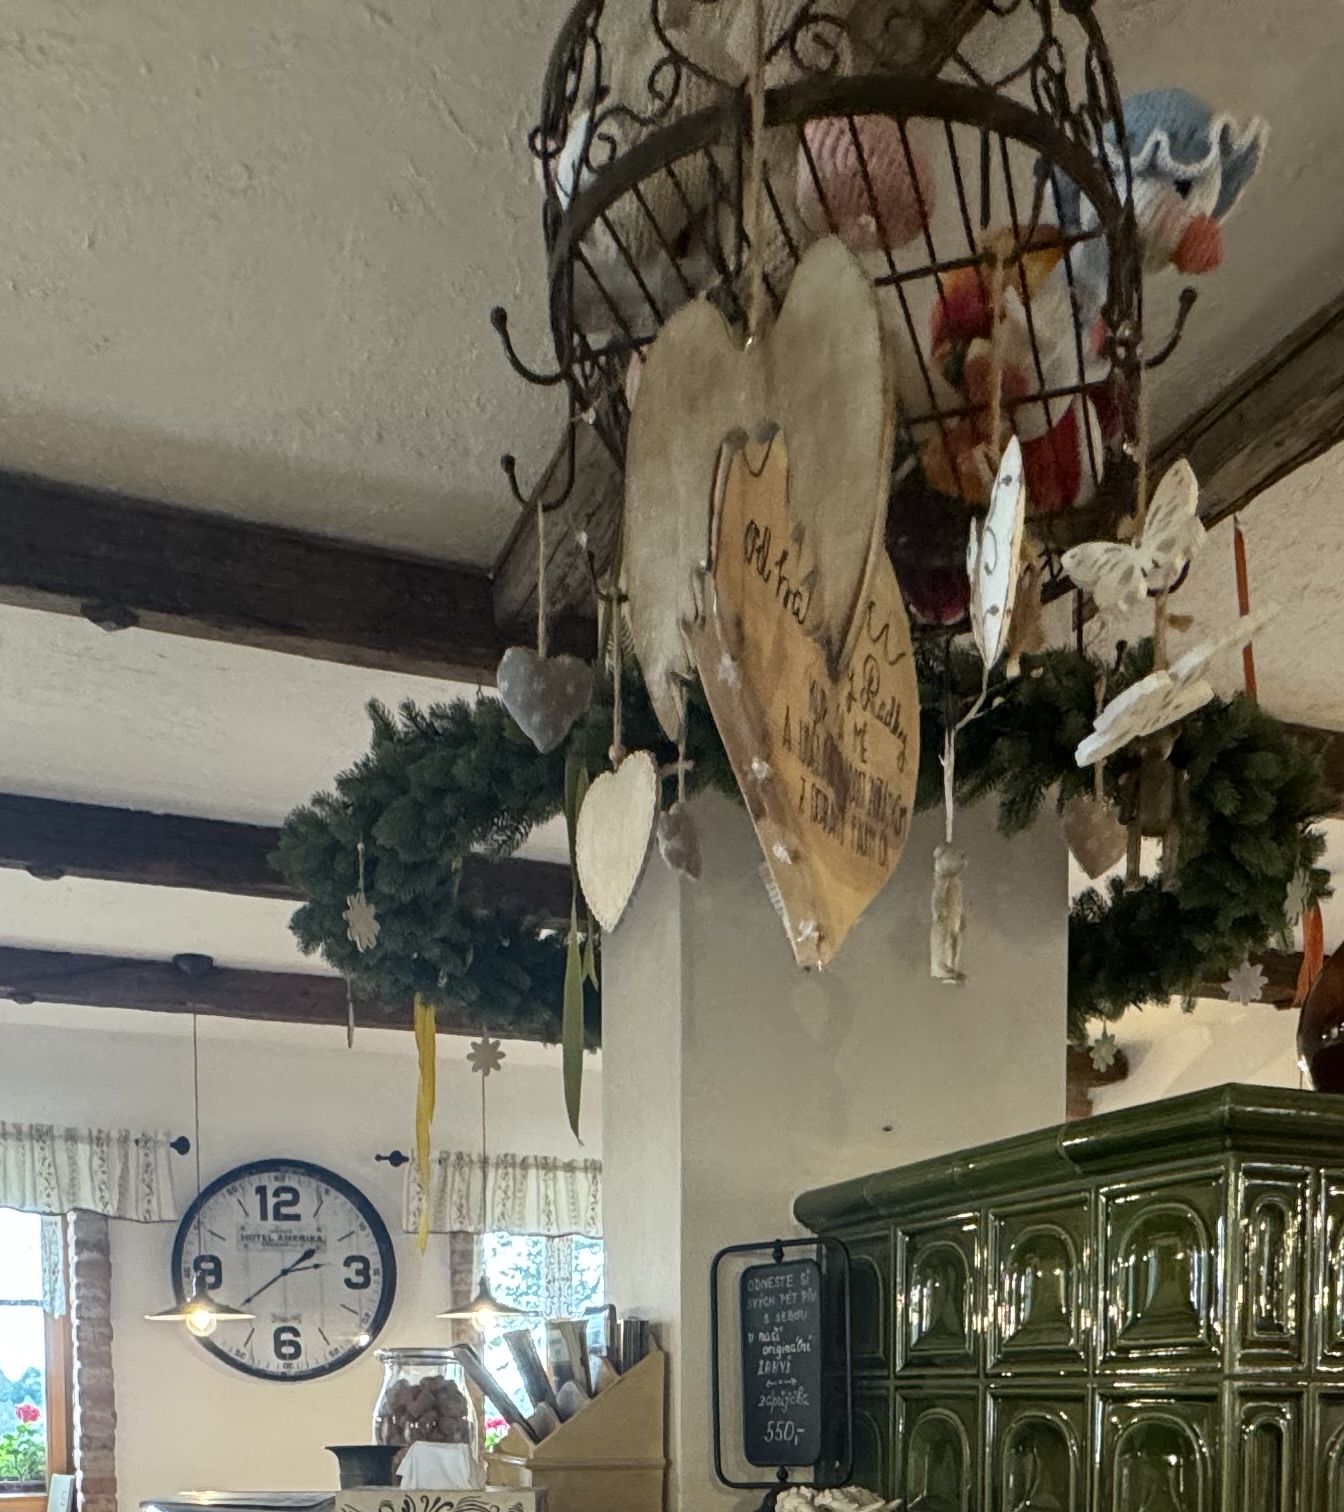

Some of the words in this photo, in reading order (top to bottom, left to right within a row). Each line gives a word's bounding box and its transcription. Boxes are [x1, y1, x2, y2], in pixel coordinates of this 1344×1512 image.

[254, 1184, 302, 1222] 12
[342, 1254, 372, 1290] 3
[273, 1325, 303, 1361] 6
